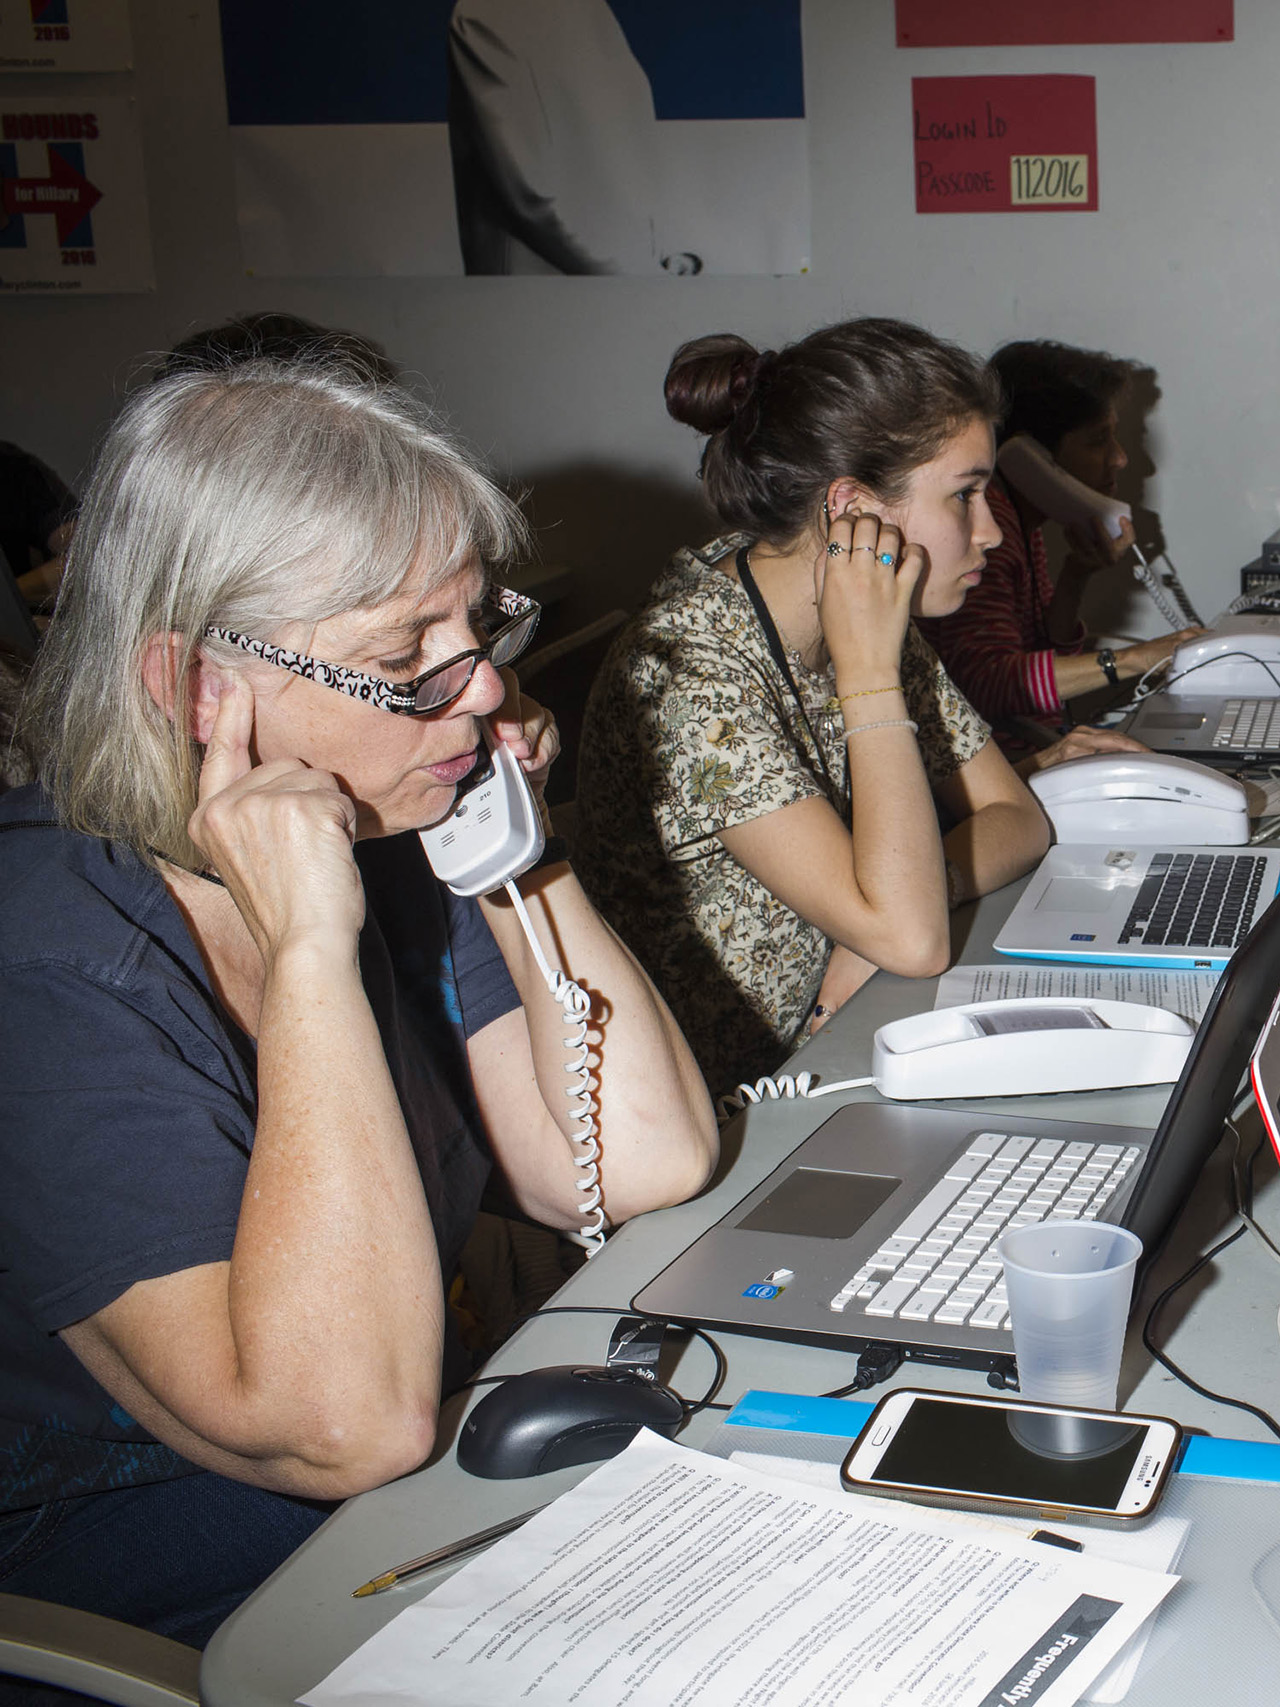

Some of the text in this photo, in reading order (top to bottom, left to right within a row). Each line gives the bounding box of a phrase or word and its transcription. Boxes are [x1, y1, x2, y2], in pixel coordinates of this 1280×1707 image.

[34, 26, 70, 42] 2016
[1012, 158, 1084, 200] 112016
[15, 187, 80, 202] for Hillary
[1136, 1455, 1153, 1481] SAMSUNG
[1000, 1632, 1079, 1706] Frequently
